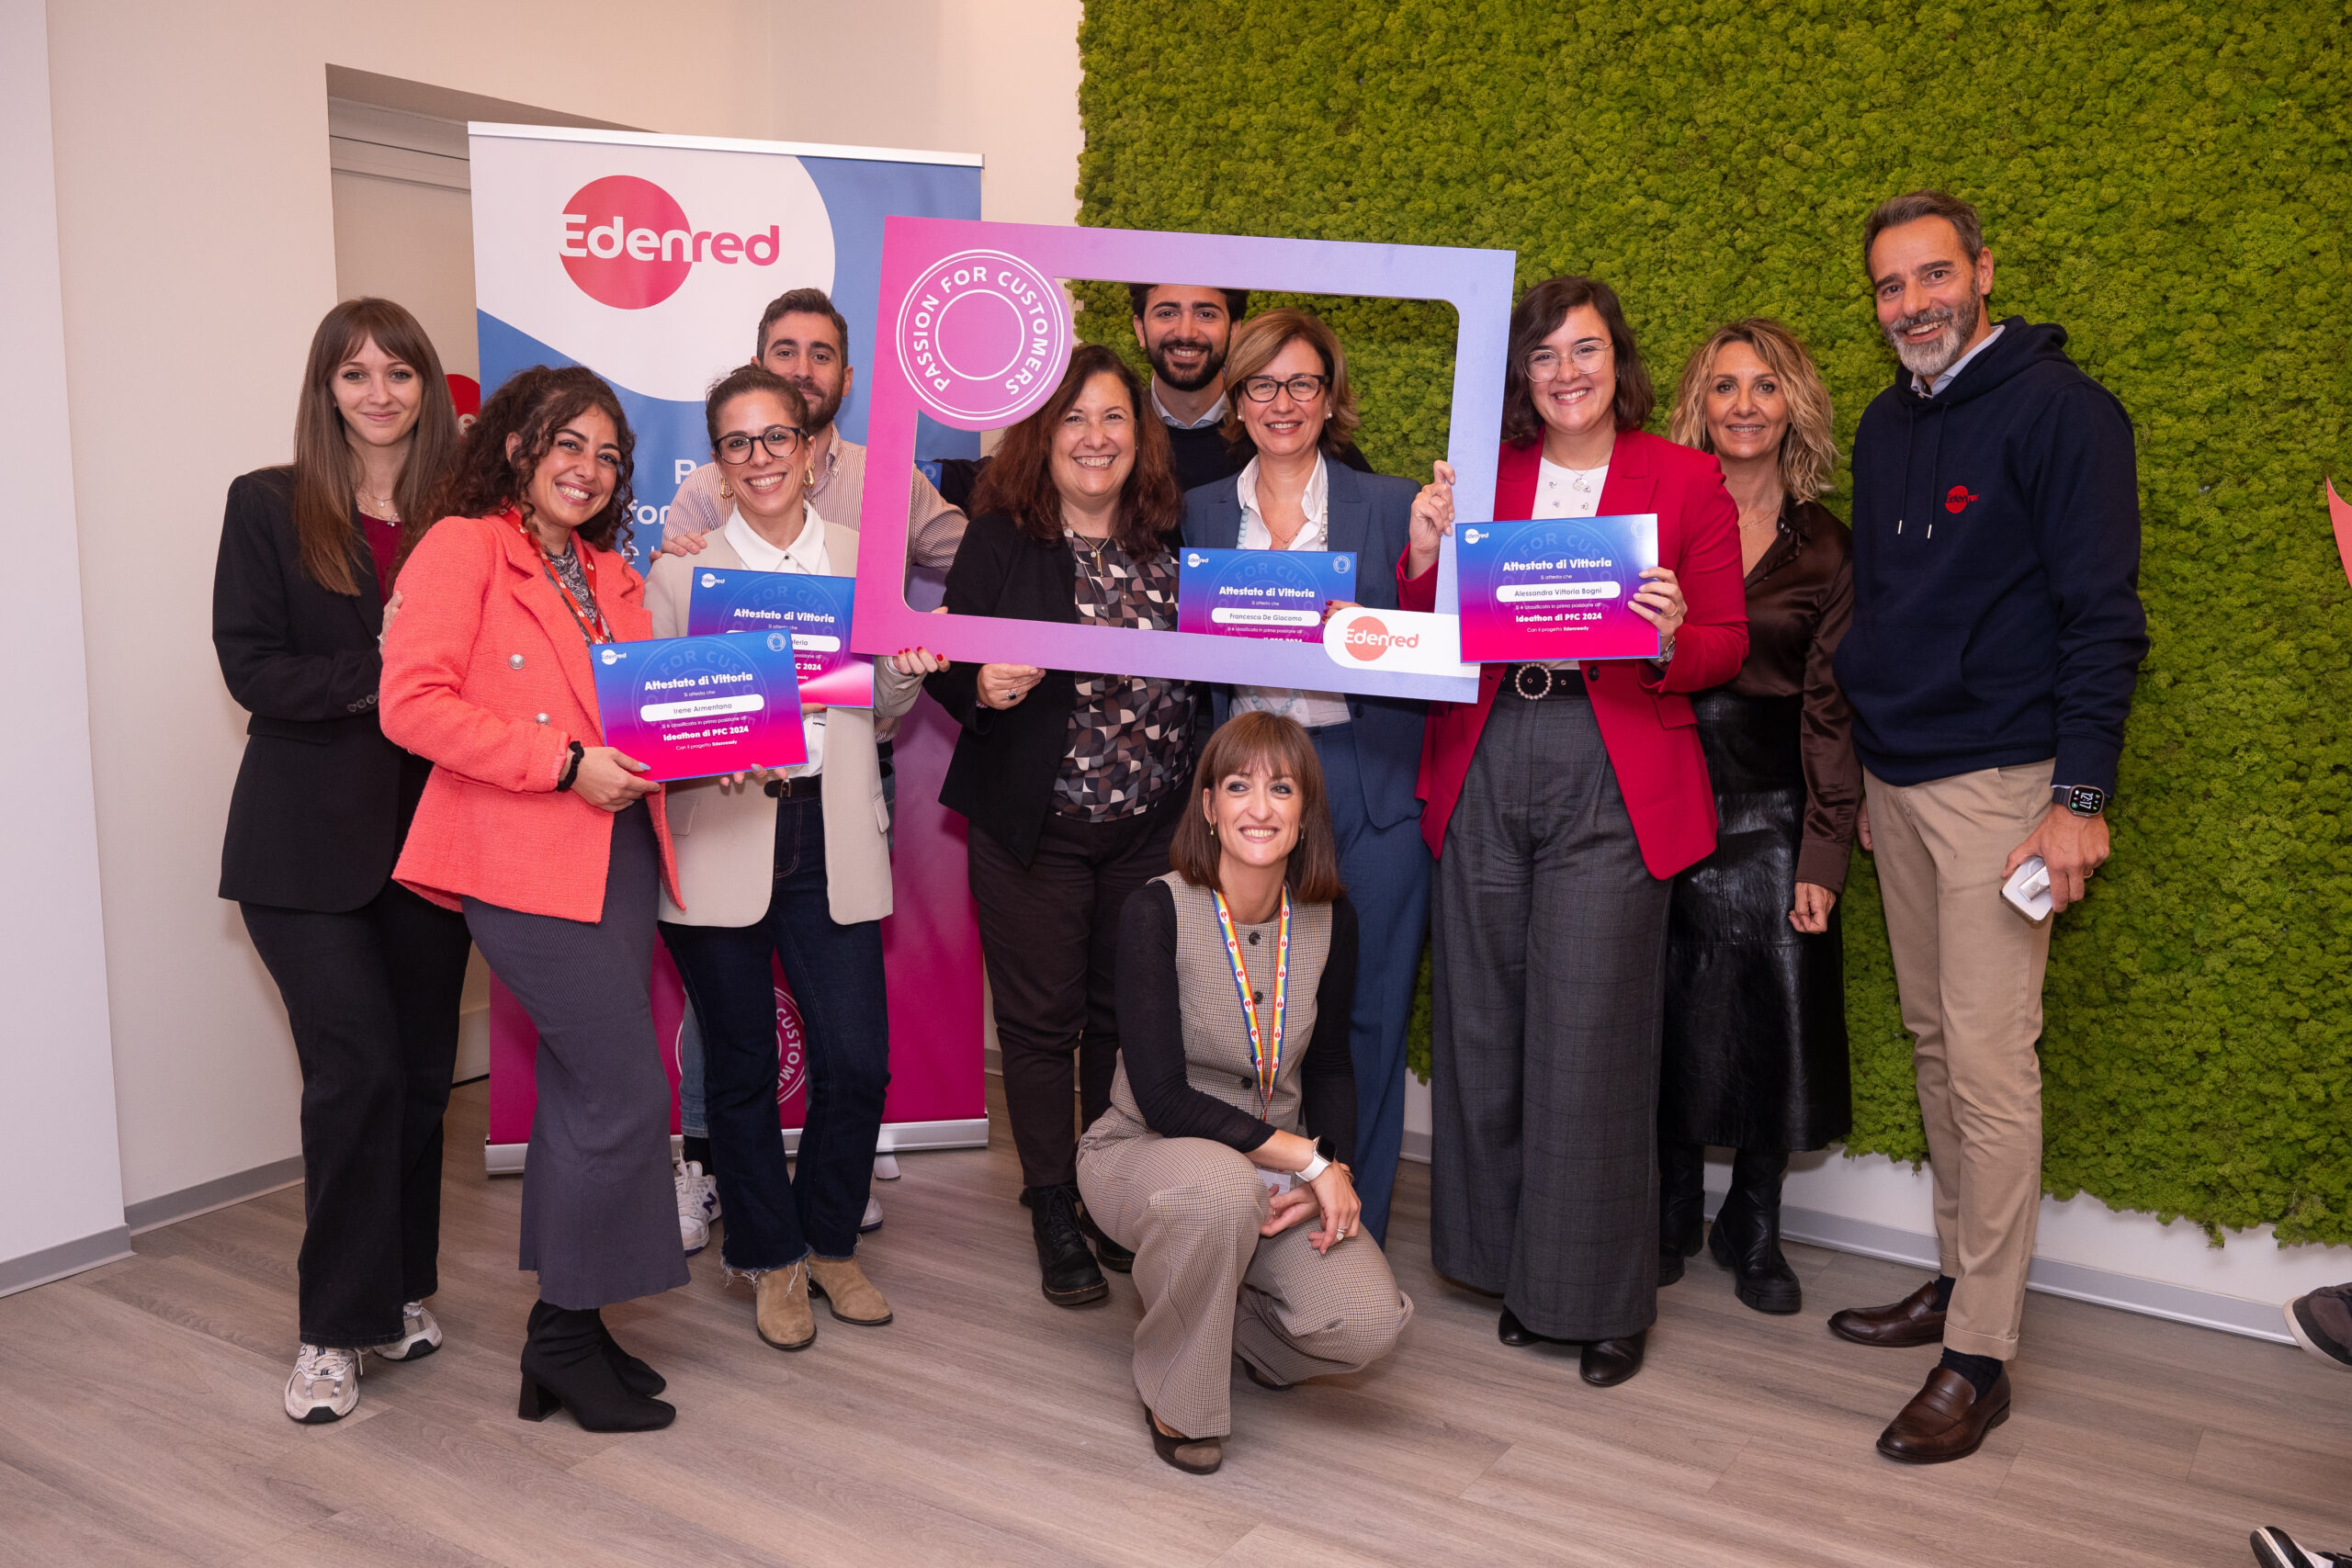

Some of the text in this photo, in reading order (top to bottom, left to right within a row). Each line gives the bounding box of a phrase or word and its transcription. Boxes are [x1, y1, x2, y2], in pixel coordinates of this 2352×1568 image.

[560, 214, 779, 266] Edenred
[913, 266, 1048, 395] PASSION FOR CUSTOMERS
[1503, 558, 1611, 571] Attestato di Vittoria
[1218, 586, 1316, 598] Attestato di Vittoria
[734, 608, 835, 623] Attestato di Vittoria
[1516, 615, 1553, 623] Ideathon
[1565, 613, 1580, 621] PFC
[1345, 628, 1419, 649] Edenred
[601, 652, 627, 660] Edenred
[644, 671, 753, 691] Attestato di Vittoria
[694, 704, 732, 712] Armentano
[662, 725, 750, 741] Ideathon di PFC 2024
[690, 742, 711, 750] progetto
[776, 1008, 801, 1090] CUSTOM
